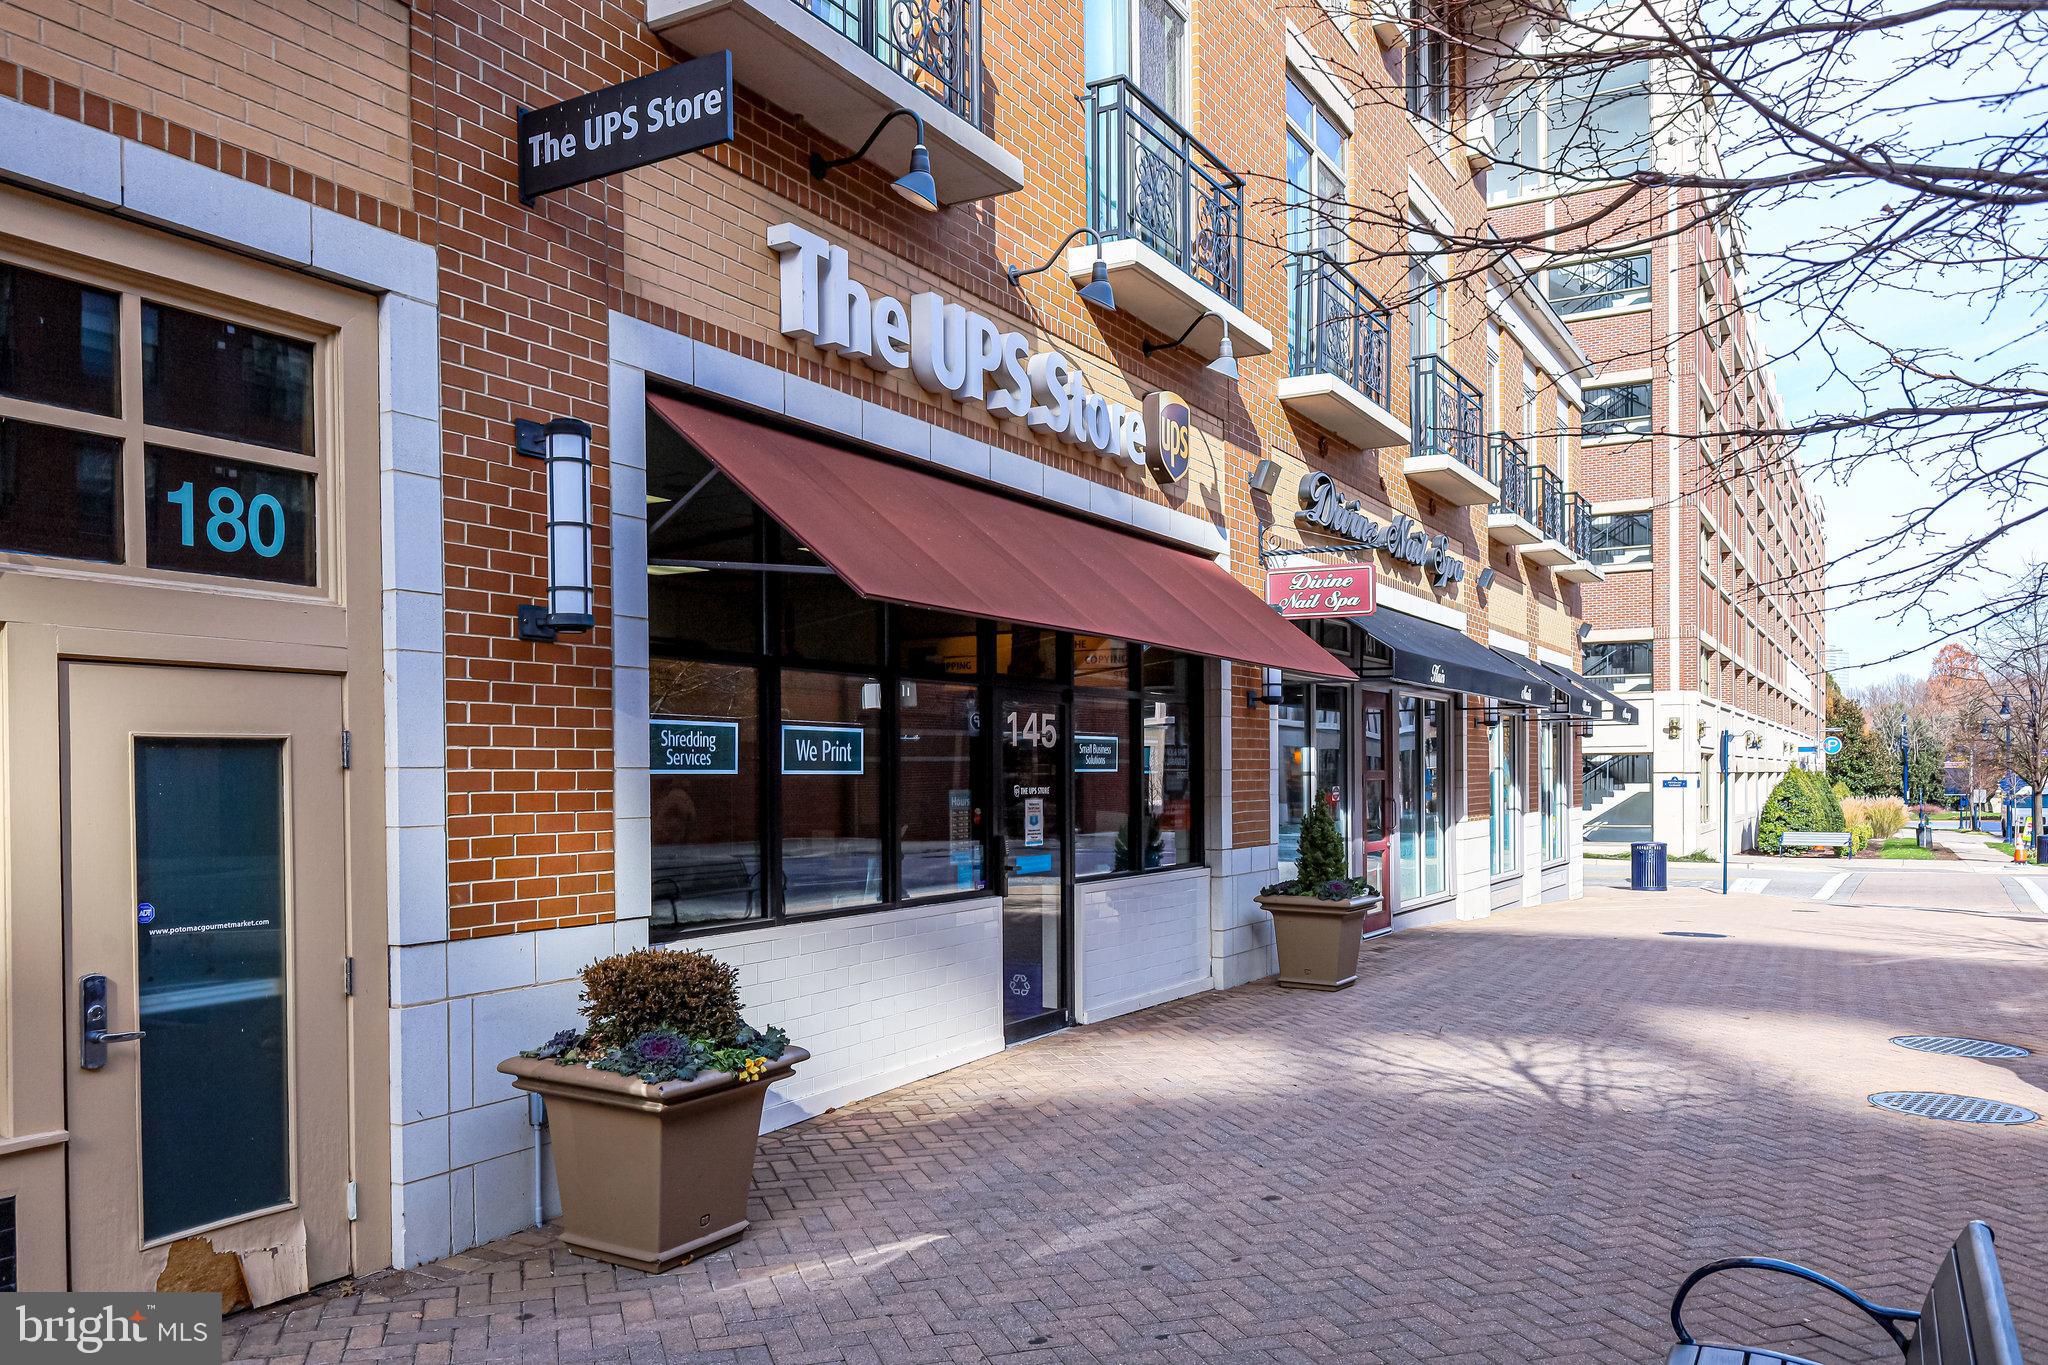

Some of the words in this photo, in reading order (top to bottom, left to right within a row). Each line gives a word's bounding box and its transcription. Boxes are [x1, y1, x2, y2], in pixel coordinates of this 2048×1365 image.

[529, 131, 576, 168] The
[584, 105, 639, 151] UPS
[647, 88, 723, 133] Store
[767, 222, 910, 372] The
[911, 292, 1032, 419] UPS
[1028, 350, 1146, 467] Store
[167, 481, 286, 558] 180
[1295, 471, 1379, 544] Divine
[1378, 514, 1429, 566] Nail
[1424, 534, 1465, 588] Spa
[1289, 572, 1354, 590] Divine
[1279, 591, 1321, 610] Nail
[1325, 590, 1361, 612] Spa
[660, 729, 716, 752] Shredding
[1007, 711, 1057, 748] 145
[666, 748, 712, 766] Services
[795, 739, 818, 762] We
[822, 740, 852, 762] Print
[1079, 743, 1093, 754] Small
[1093, 744, 1112, 755] Business
[1085, 754, 1106, 765] Solutions
[138, 909, 151, 917] ADT
[149, 919, 270, 935] www.potomacgourmetmarket.com
